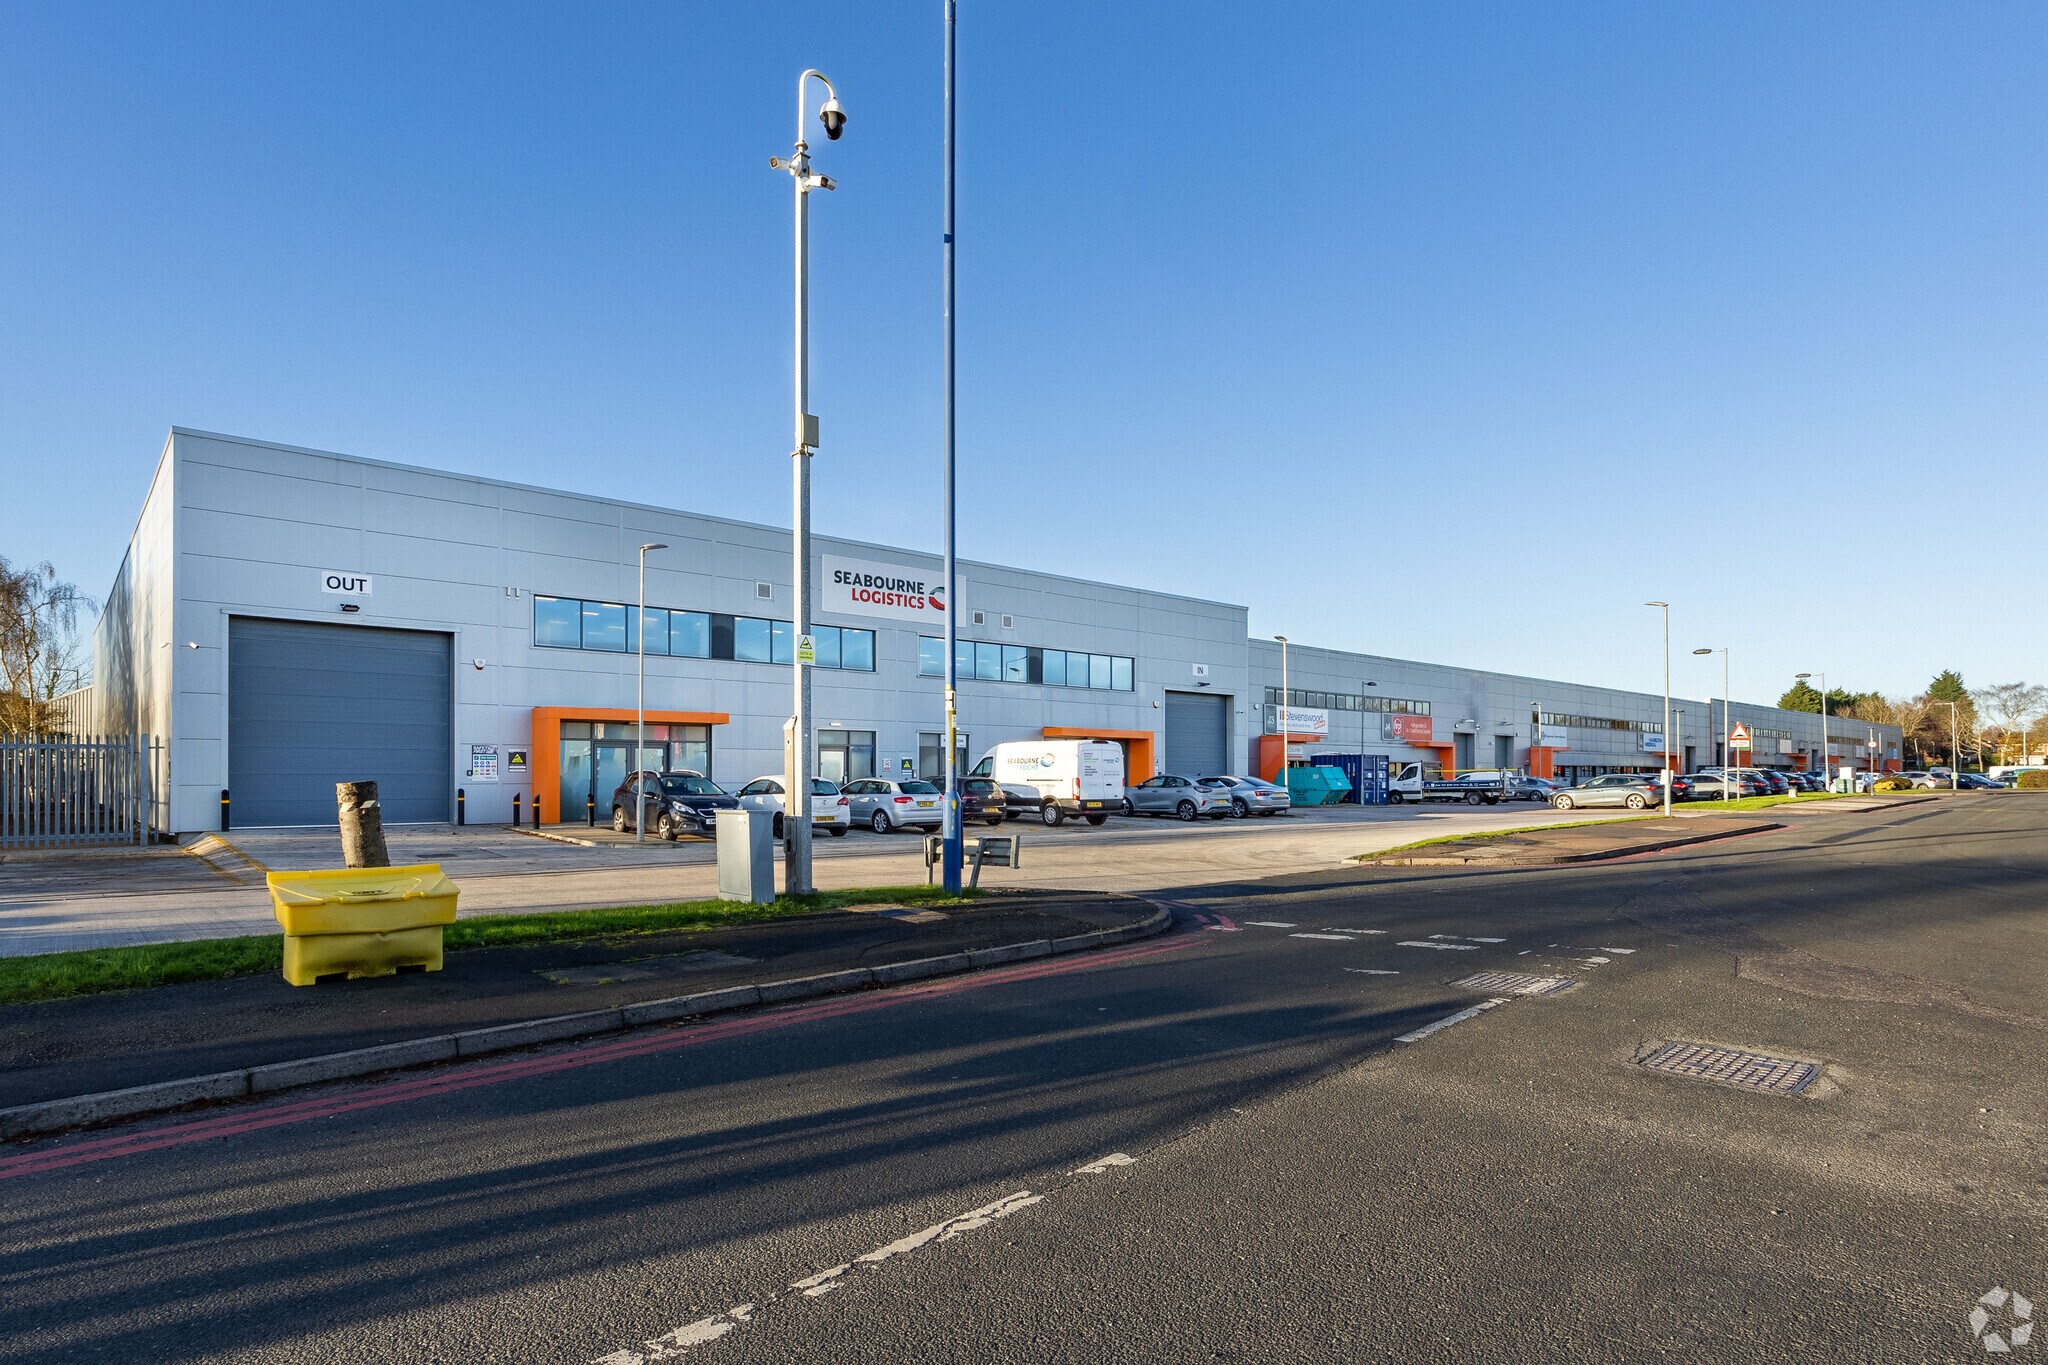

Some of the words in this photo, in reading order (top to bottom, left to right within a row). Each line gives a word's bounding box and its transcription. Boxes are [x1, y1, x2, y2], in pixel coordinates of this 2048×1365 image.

[326, 575, 368, 592] OUT
[834, 570, 924, 594] SEABOURNE
[851, 587, 925, 610] LOGISTICS
[1196, 666, 1204, 675] IN
